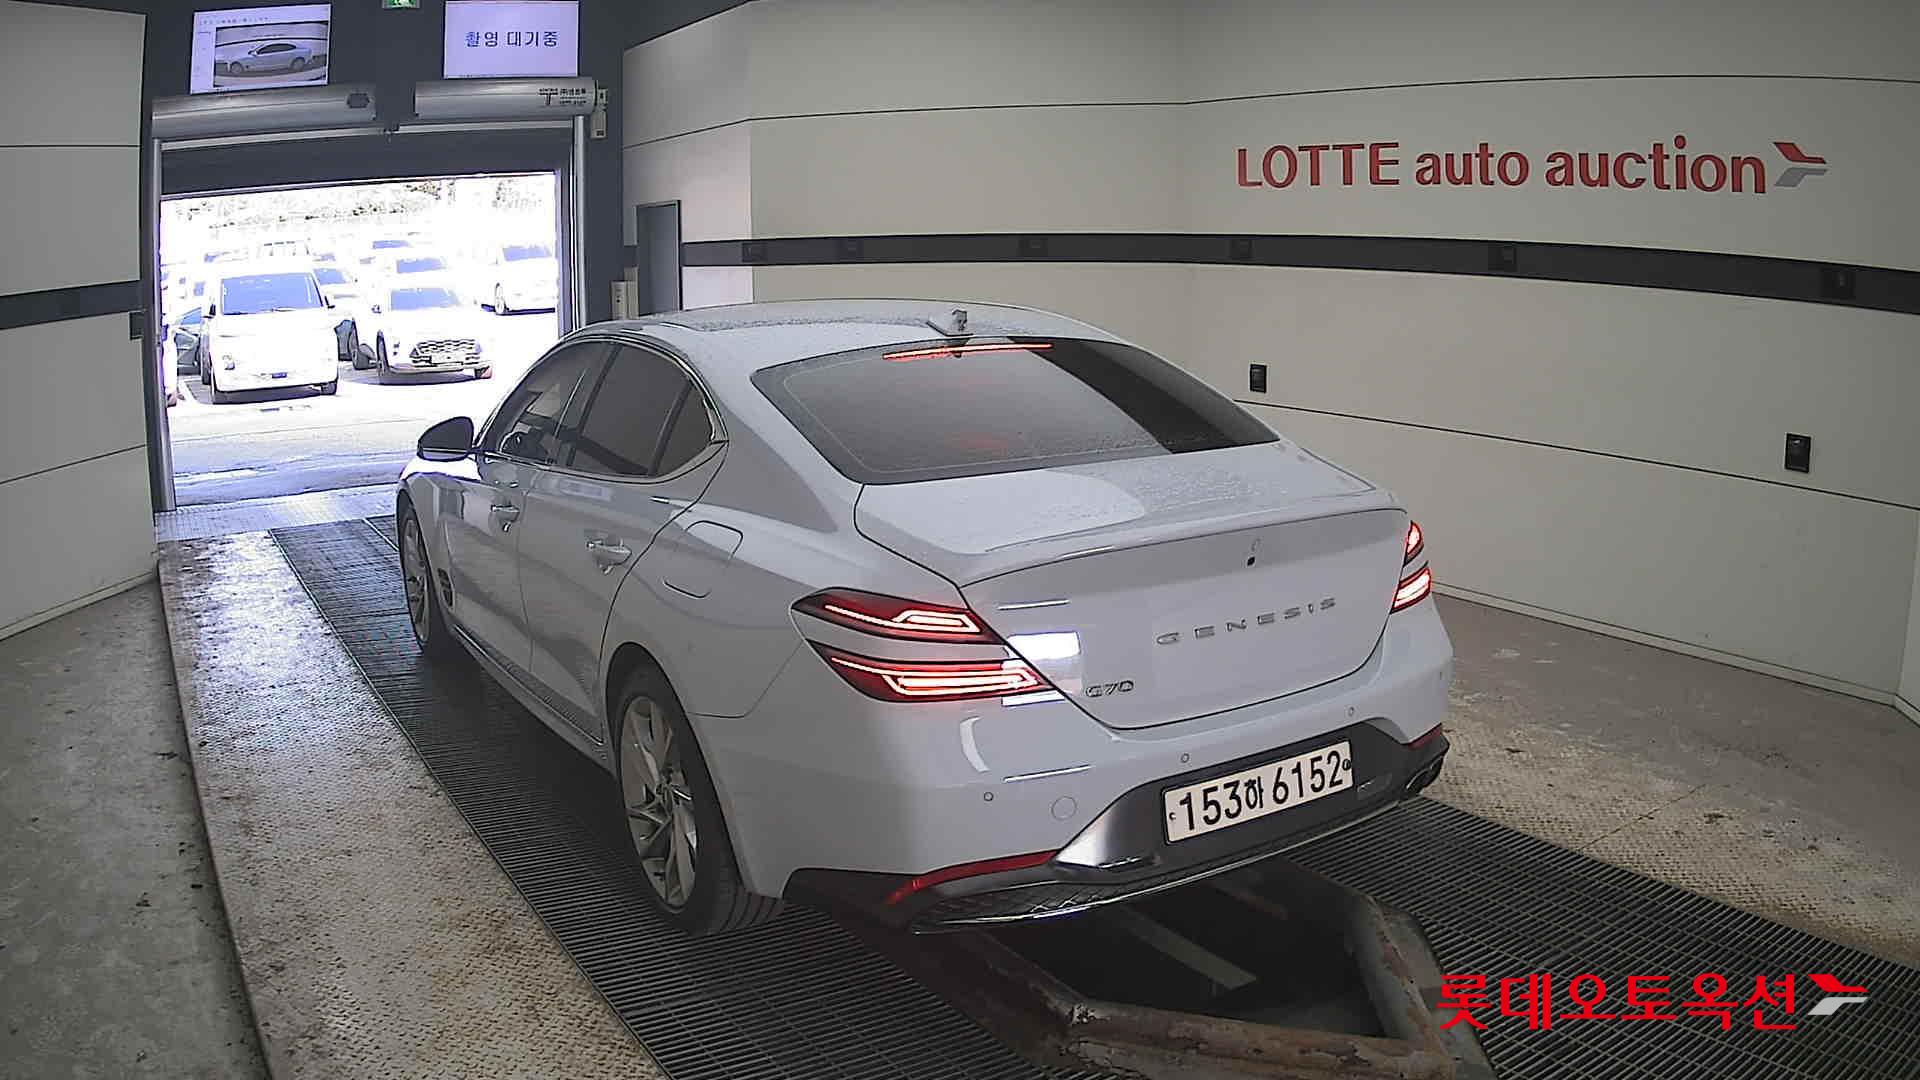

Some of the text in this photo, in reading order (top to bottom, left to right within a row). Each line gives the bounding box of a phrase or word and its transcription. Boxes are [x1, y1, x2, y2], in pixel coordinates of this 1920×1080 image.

[465, 31, 559, 48] 촬영 대기중
[1237, 135, 1767, 195] LOTTE auto auction
[1156, 597, 1336, 645] GENESIS
[1085, 680, 1135, 698] G70
[1179, 750, 1344, 831] 153하 6152
